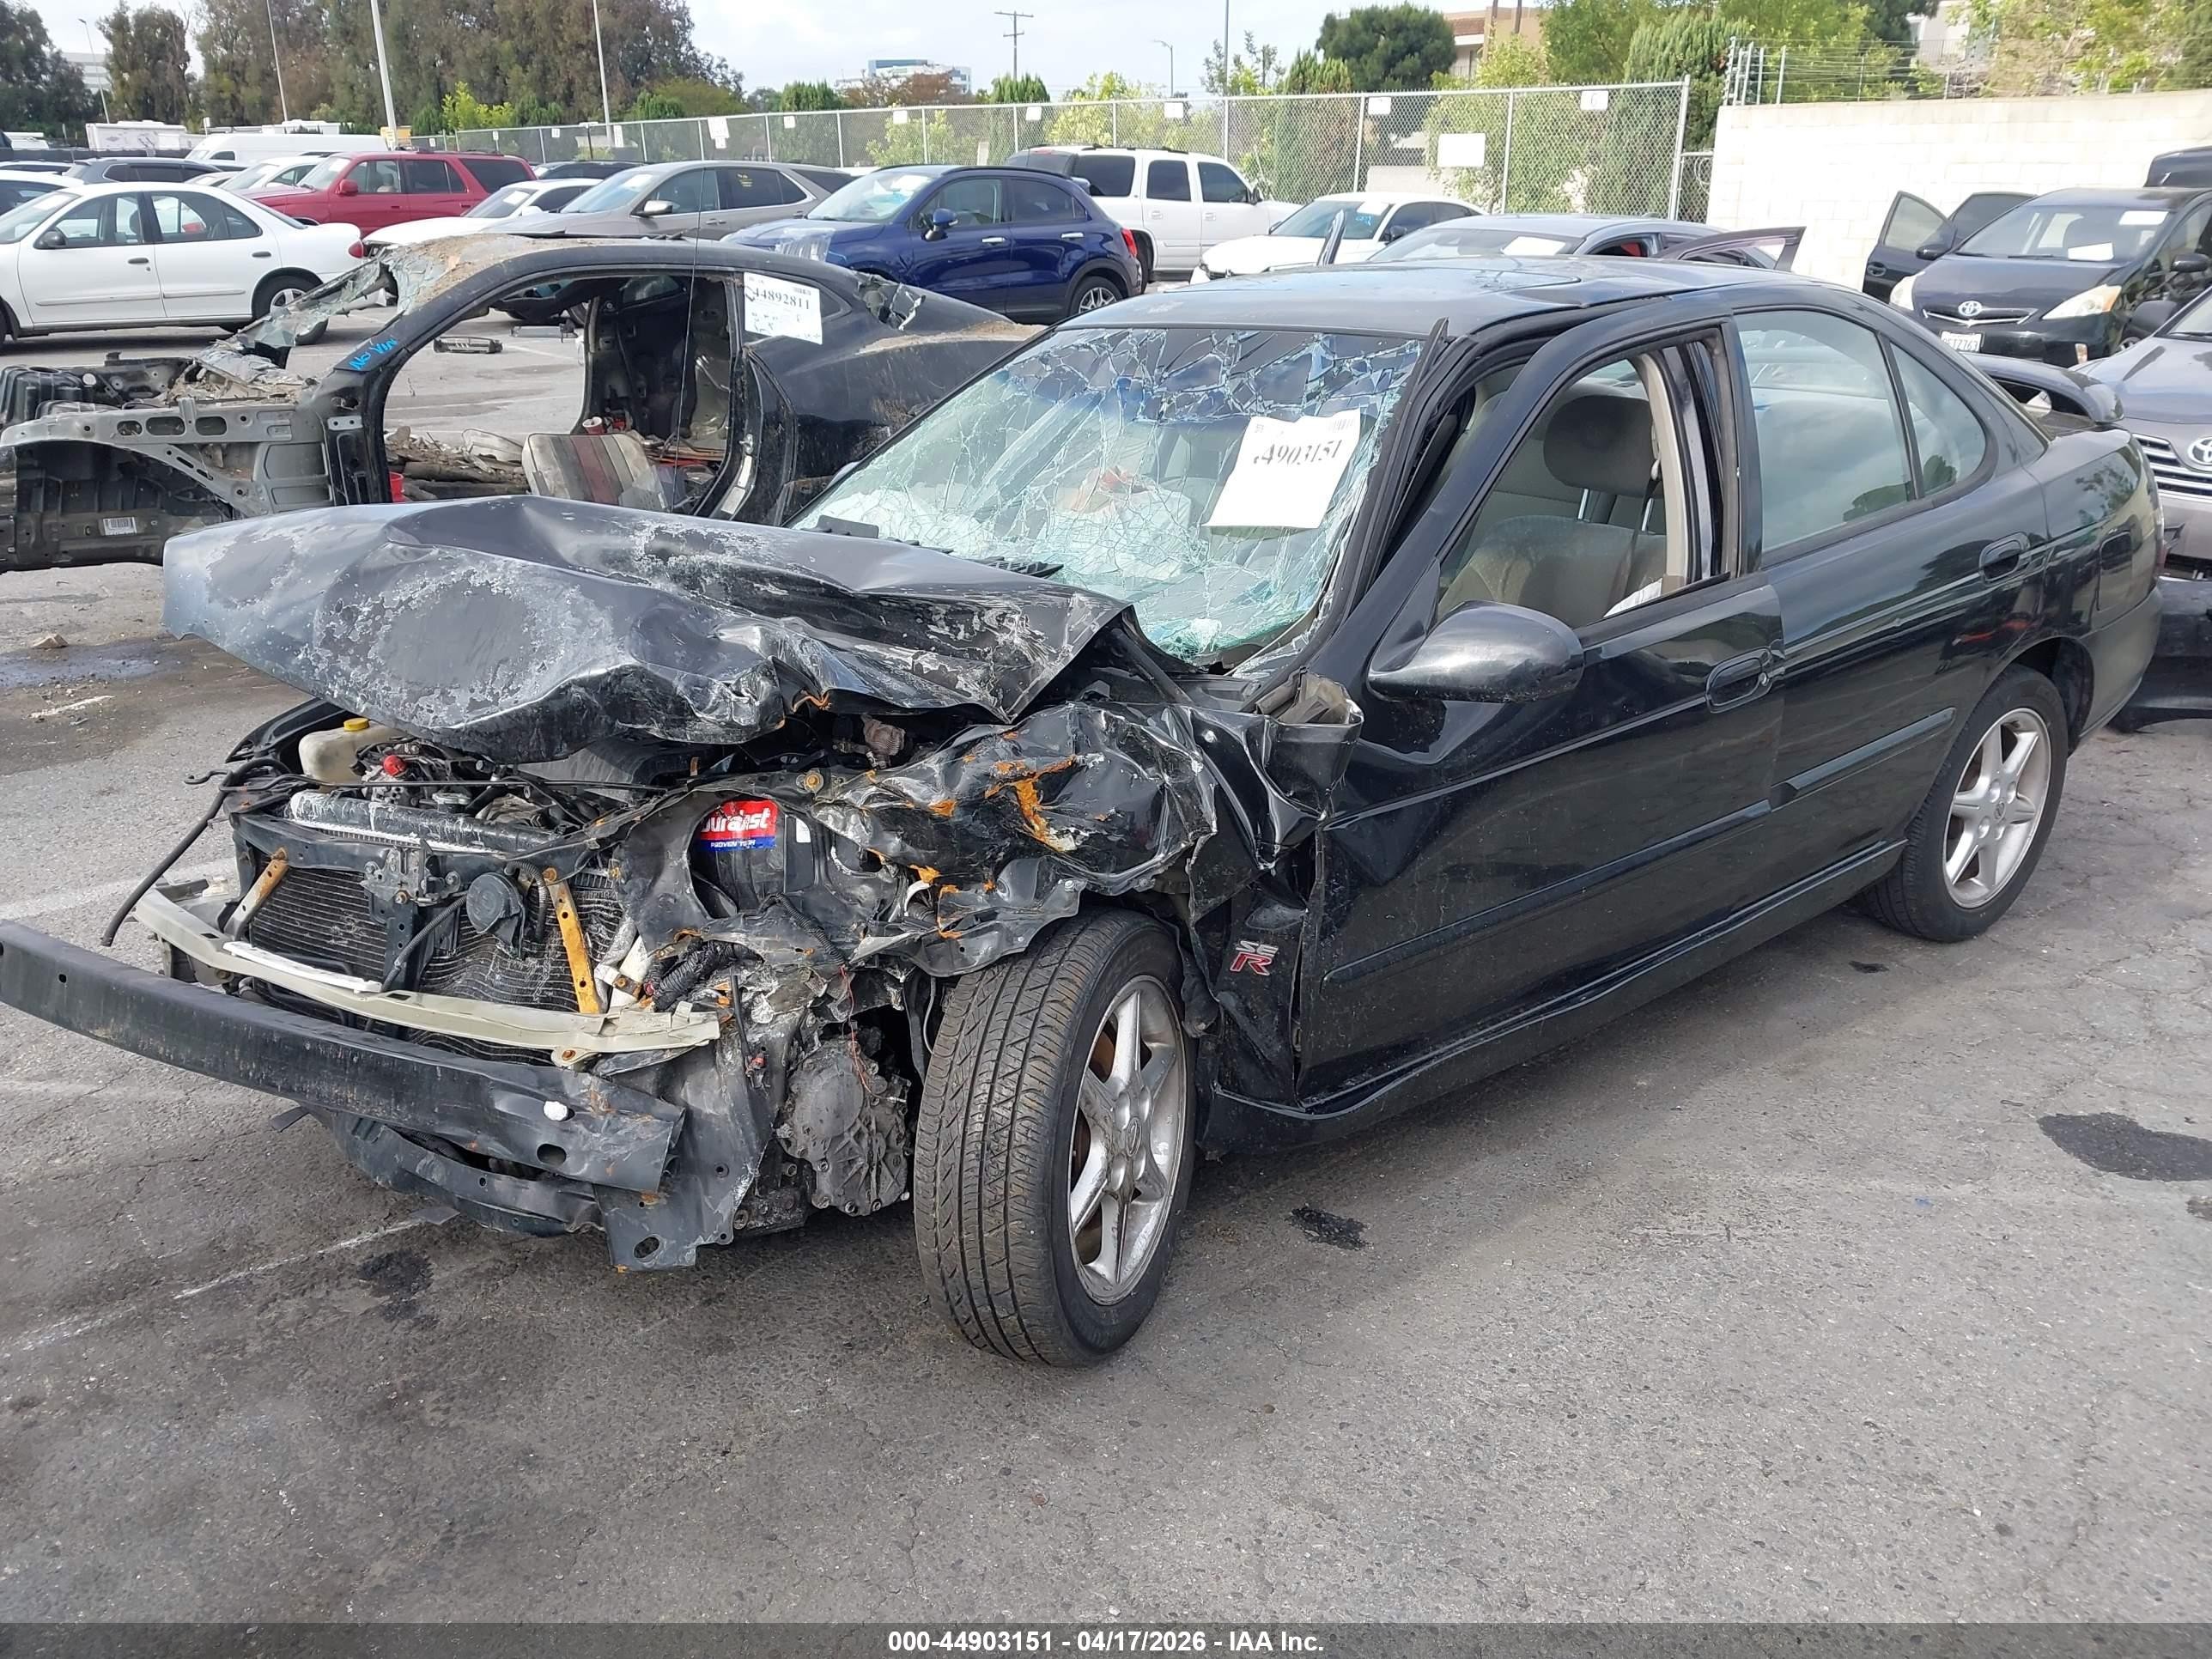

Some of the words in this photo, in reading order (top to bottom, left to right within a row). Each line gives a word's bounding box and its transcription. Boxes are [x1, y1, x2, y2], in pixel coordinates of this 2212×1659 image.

[753, 287, 810, 310] 44892811
[1253, 439, 1343, 466] 4903151
[1235, 939, 1279, 958] SE
[1229, 951, 1273, 977] R
